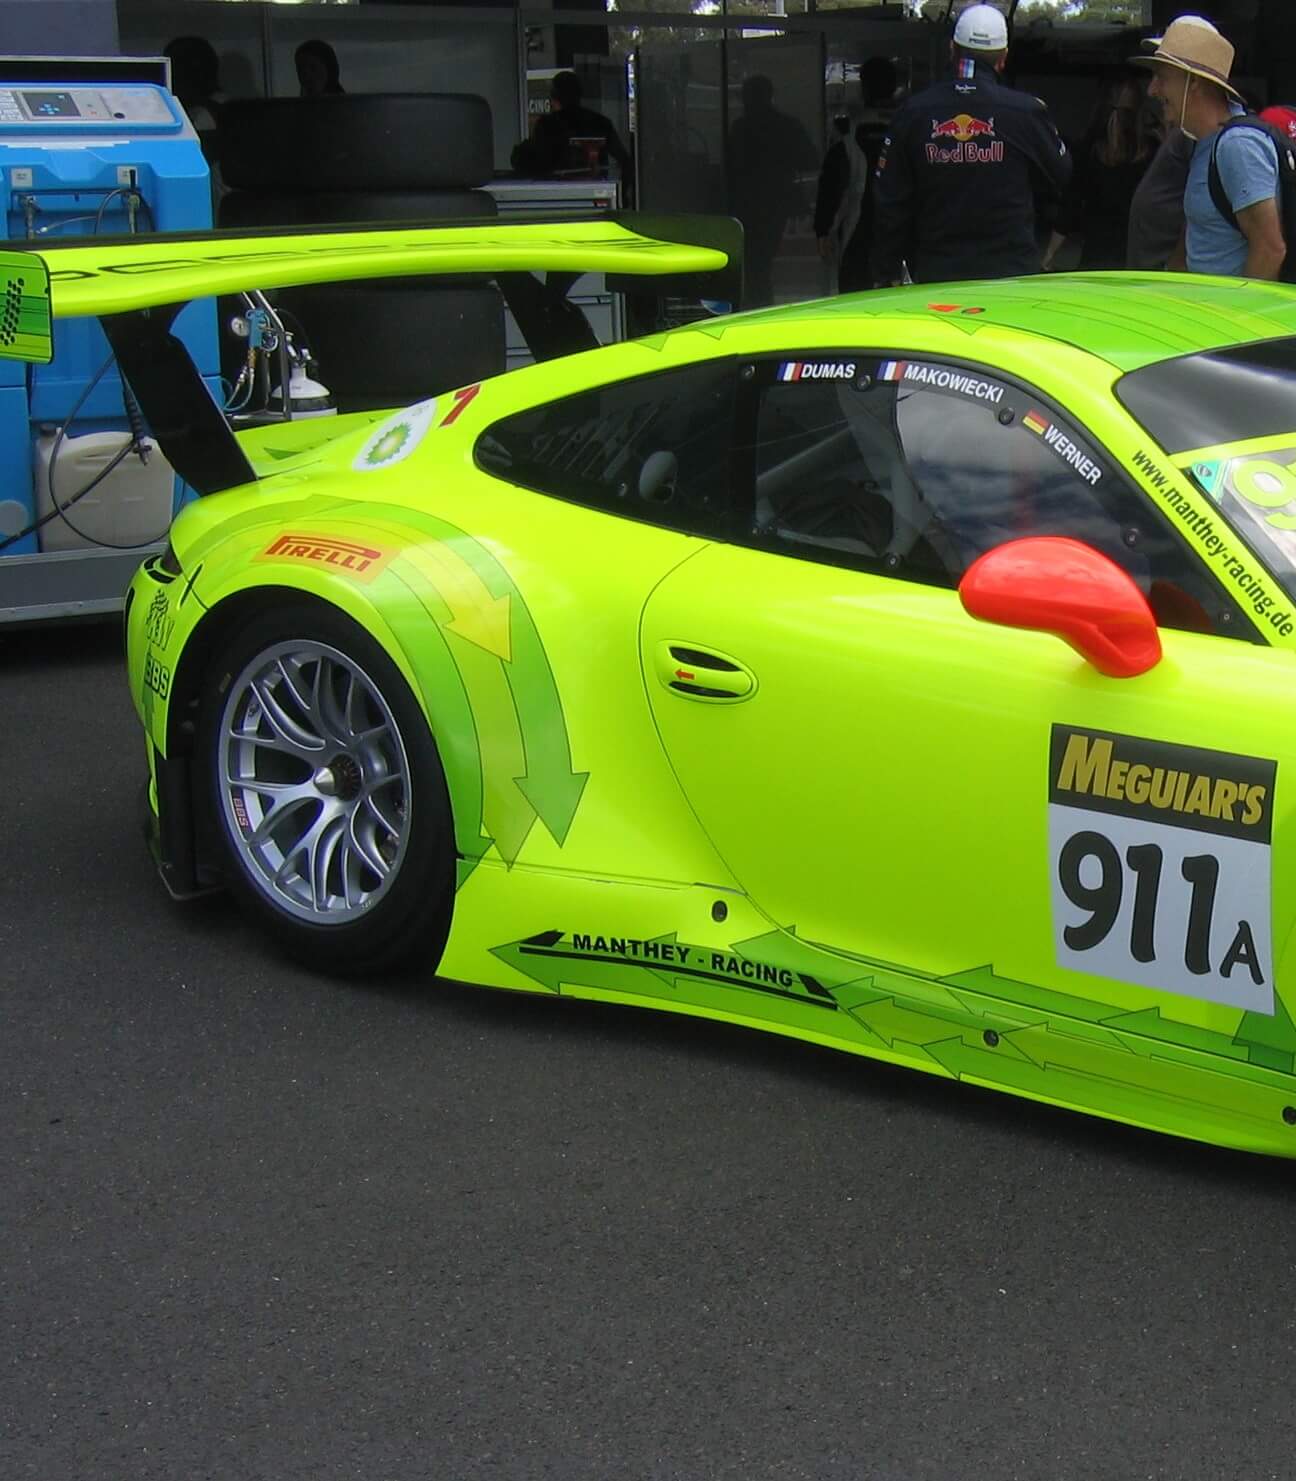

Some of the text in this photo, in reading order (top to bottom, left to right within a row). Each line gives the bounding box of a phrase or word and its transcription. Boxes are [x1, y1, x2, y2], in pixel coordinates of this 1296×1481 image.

[925, 141, 1004, 163] Red Bull
[800, 363, 857, 379] DUMAS
[903, 364, 1005, 404] MAKOWIECKI
[1043, 423, 1104, 487] WERNER
[265, 535, 382, 573] PIRELLI
[1131, 450, 1295, 637] www.manthey-racing.de
[572, 933, 692, 964] MANTHEY
[711, 955, 794, 987] RACING
